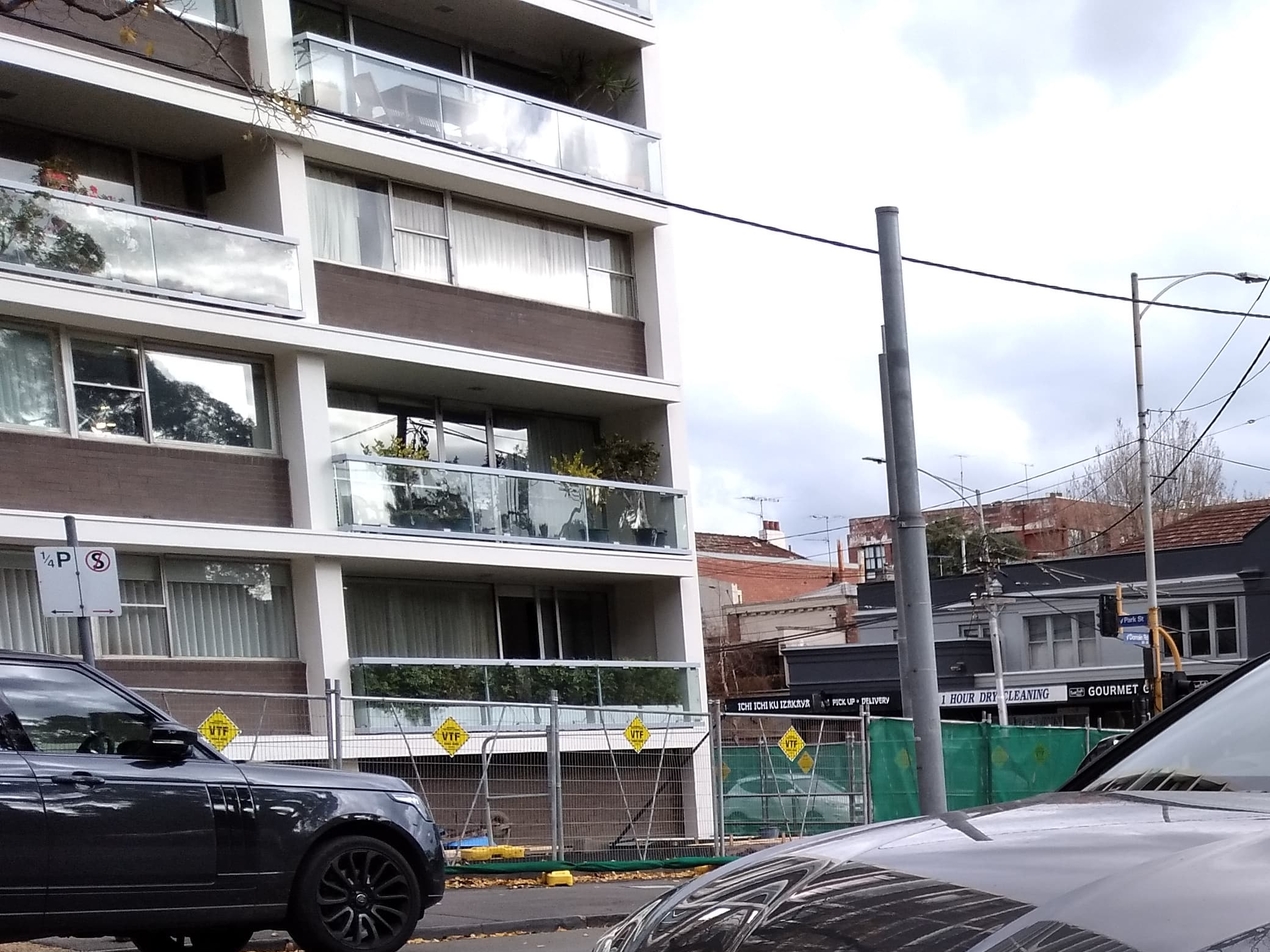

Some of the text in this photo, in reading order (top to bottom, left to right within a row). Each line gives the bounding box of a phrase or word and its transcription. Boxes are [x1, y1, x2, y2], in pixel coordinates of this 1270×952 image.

[1123, 615, 1144, 624] Park St
[1088, 684, 1139, 697] GOURMET
[832, 698, 847, 706] PICK
[847, 697, 855, 706] UP
[861, 696, 890, 705] DELIVERY
[941, 694, 946, 705] 1
[949, 692, 975, 704] HOUR
[979, 691, 997, 703] DRY
[737, 702, 752, 711] ICHI
[753, 701, 768, 710] ICHI
[769, 700, 779, 710] KU
[779, 698, 811, 709] IZAKAYA
[209, 725, 229, 736] VTF
[630, 730, 644, 739] VTF
[442, 731, 460, 741] VTF
[785, 740, 797, 748] VTF
